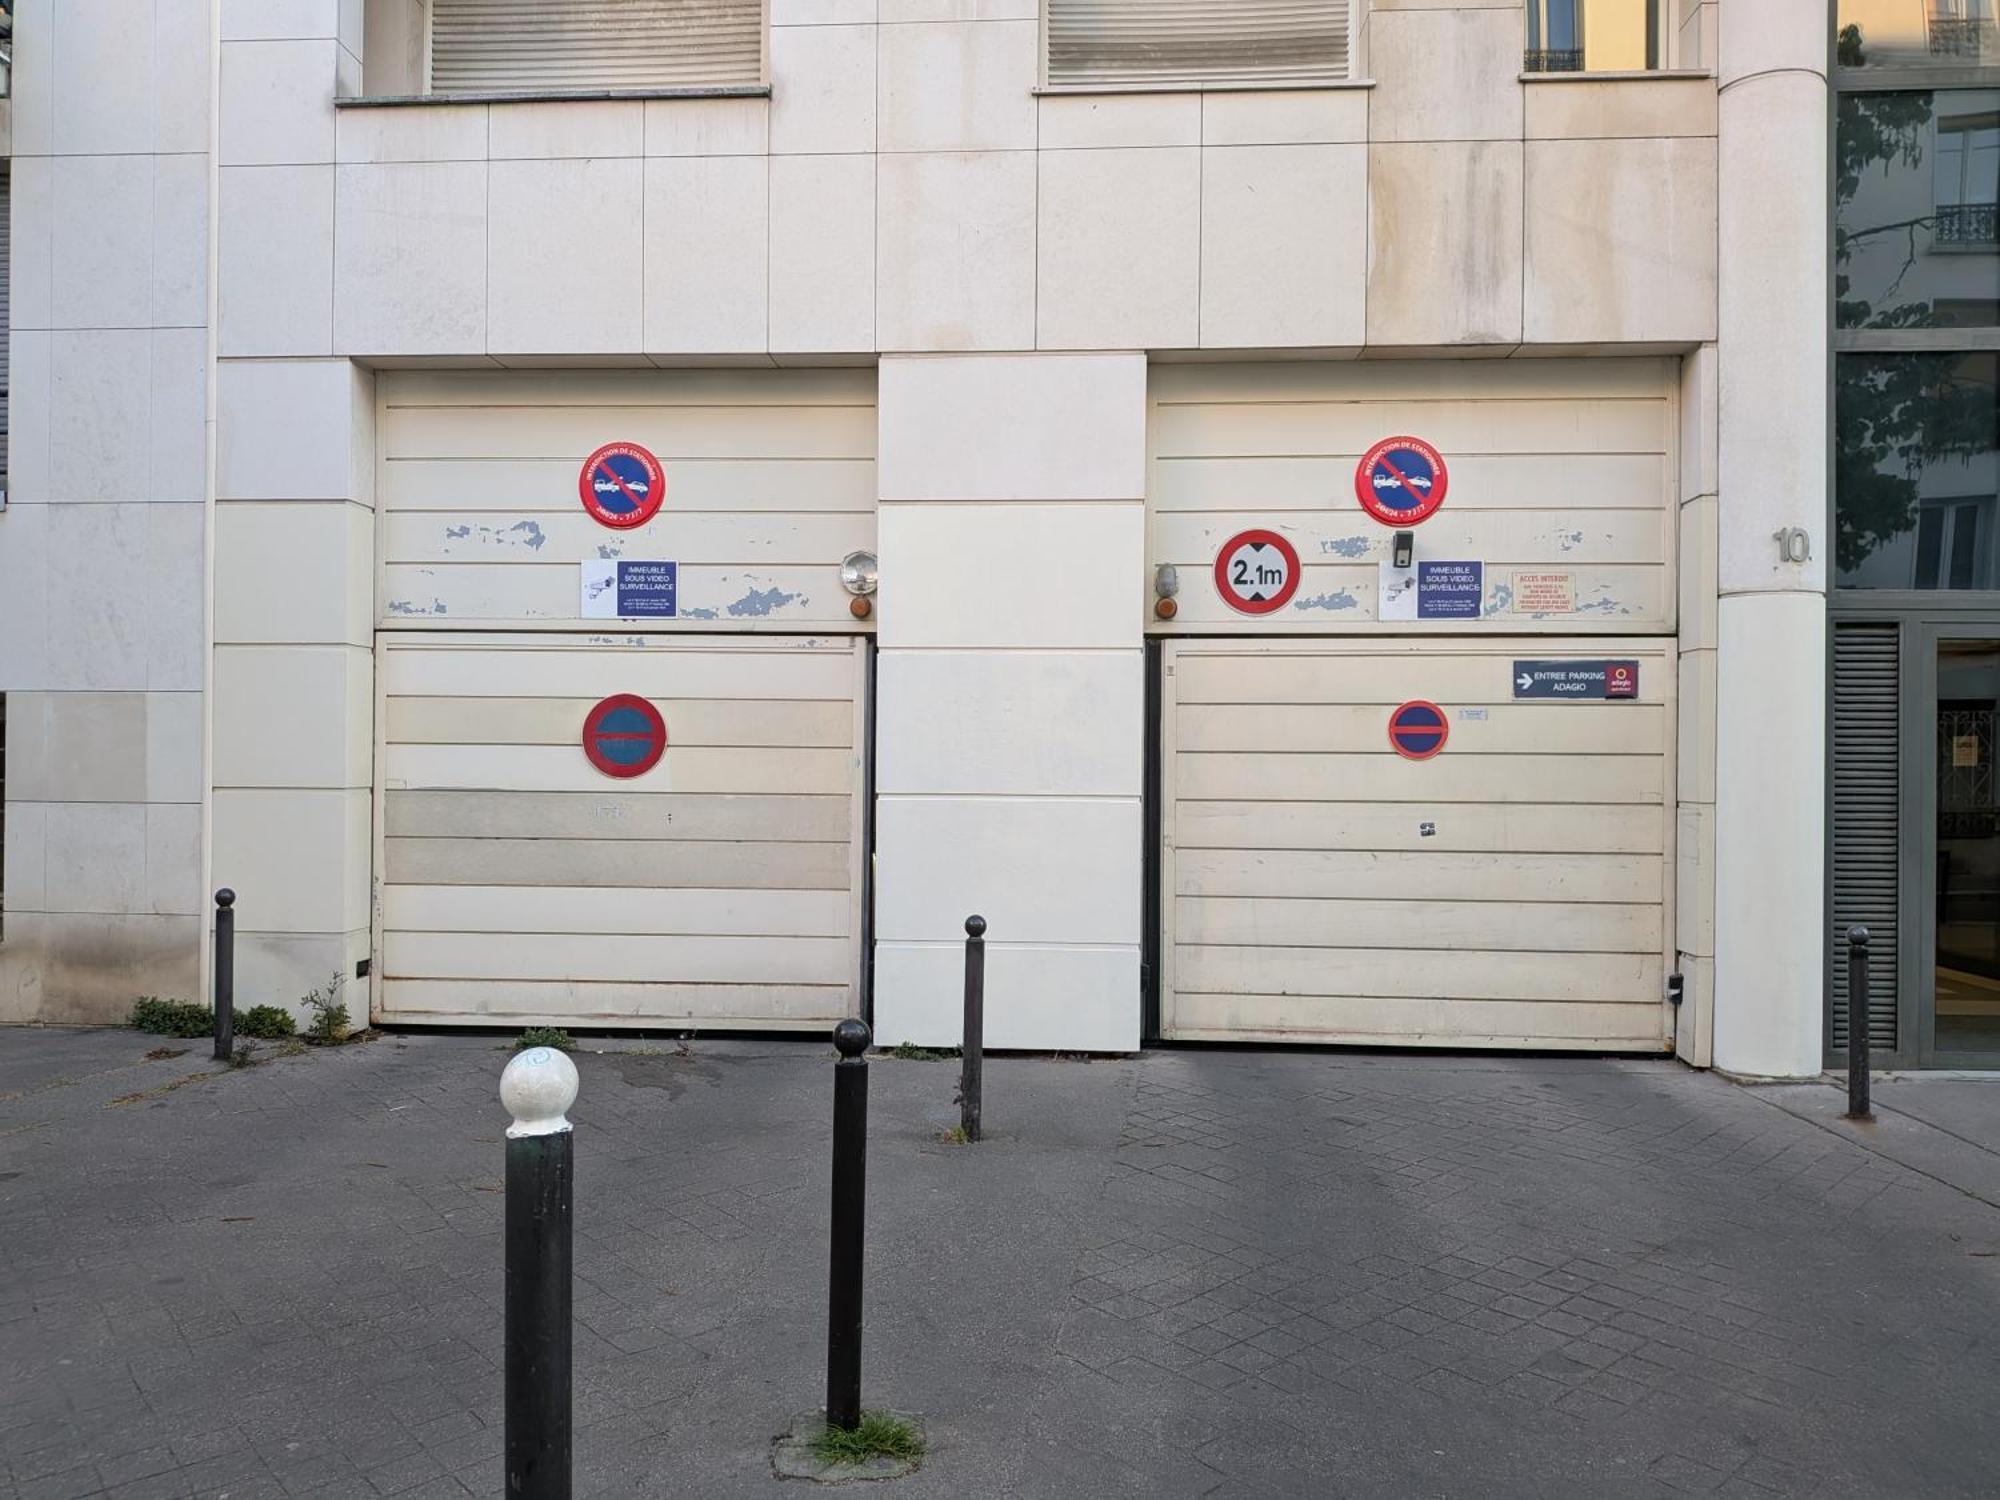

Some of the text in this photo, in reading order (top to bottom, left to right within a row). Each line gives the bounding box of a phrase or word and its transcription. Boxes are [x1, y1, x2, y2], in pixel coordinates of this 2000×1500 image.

[1364, 442, 1400, 476] INTERDICTION
[1411, 443, 1441, 476] STATIONNER
[586, 448, 619, 481] INTERDICTION
[1772, 527, 1810, 563] 10
[628, 566, 666, 574] IMMEUBLE
[1233, 559, 1282, 585] 2.1m
[1430, 566, 1470, 574] IMMEUBLE
[1426, 575, 1475, 583] SOUS VIDEO
[1420, 583, 1481, 592] SURVEILLANCE
[1534, 671, 1606, 680] ENTREE PARKING
[1553, 683, 1586, 692] ADAGIO
